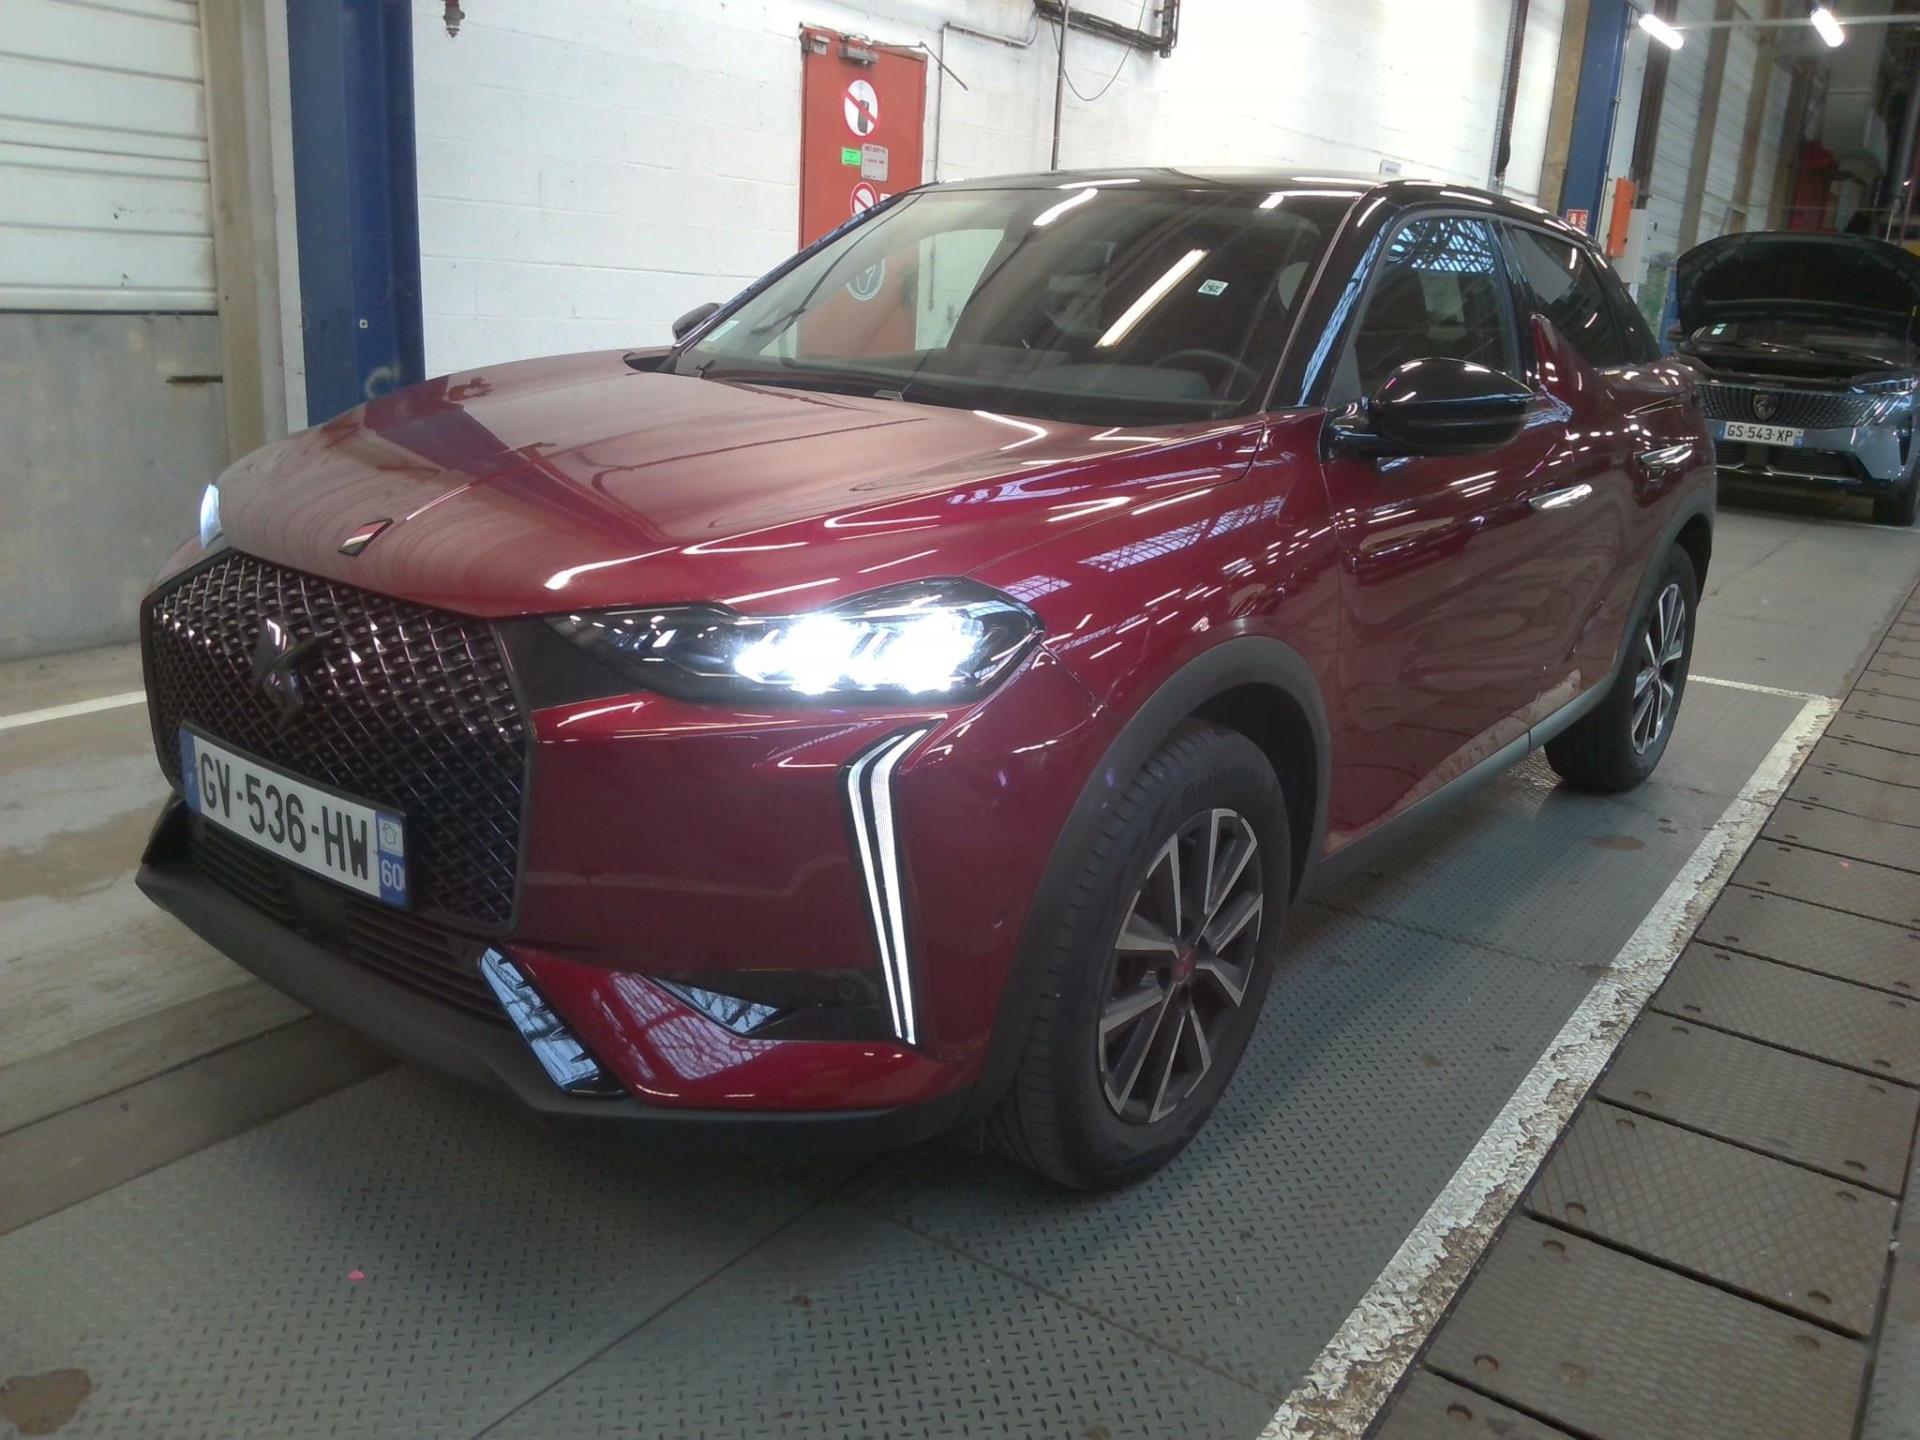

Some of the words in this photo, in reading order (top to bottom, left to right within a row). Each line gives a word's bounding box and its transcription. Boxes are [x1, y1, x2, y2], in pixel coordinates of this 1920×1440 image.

[1727, 424, 1793, 441] GS-543-XP
[201, 753, 368, 880] GV-536-HW
[381, 860, 403, 891] 60
